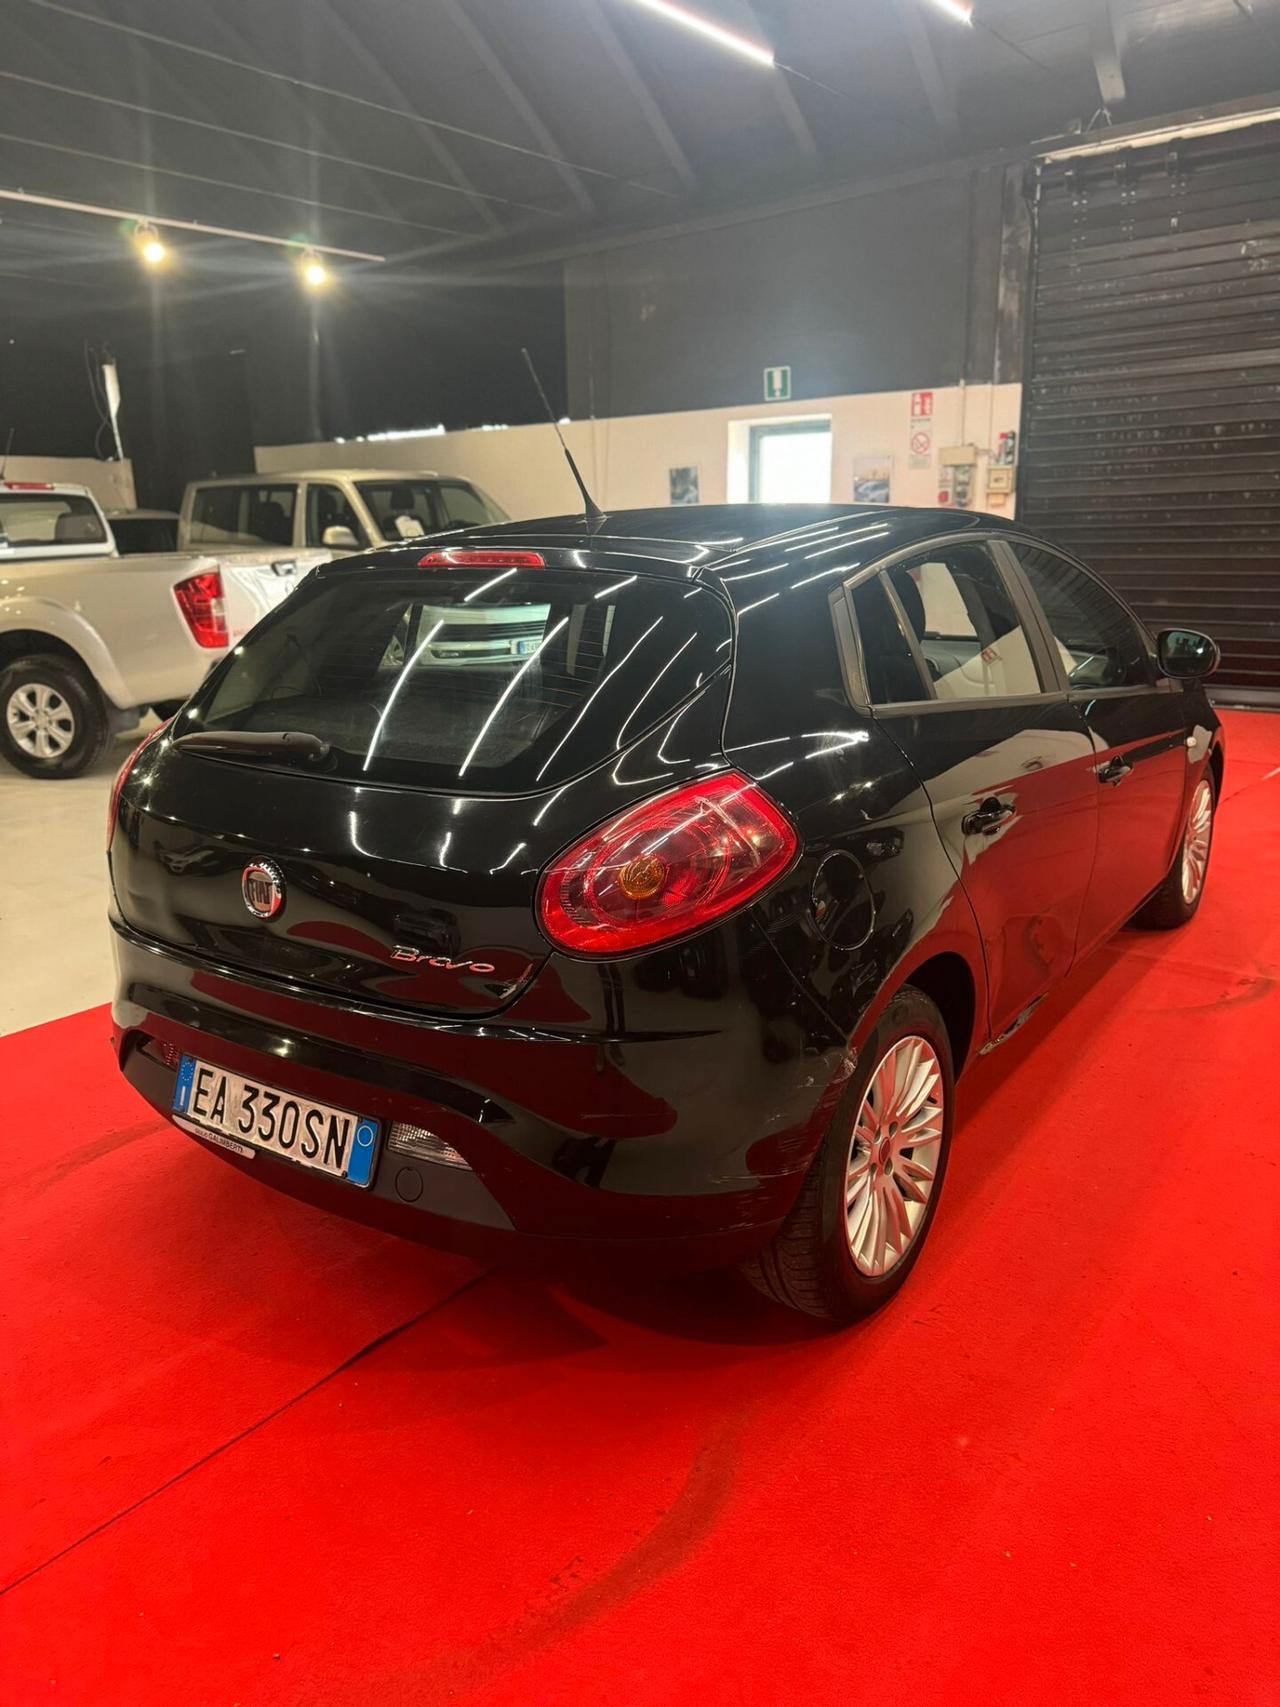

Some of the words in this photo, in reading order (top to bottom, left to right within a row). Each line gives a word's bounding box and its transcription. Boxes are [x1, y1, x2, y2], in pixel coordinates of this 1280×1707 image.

[247, 878, 273, 905] FIAT
[391, 945, 495, 972] Bravo
[193, 1068, 227, 1124] EA
[238, 1083, 350, 1169] 330SN
